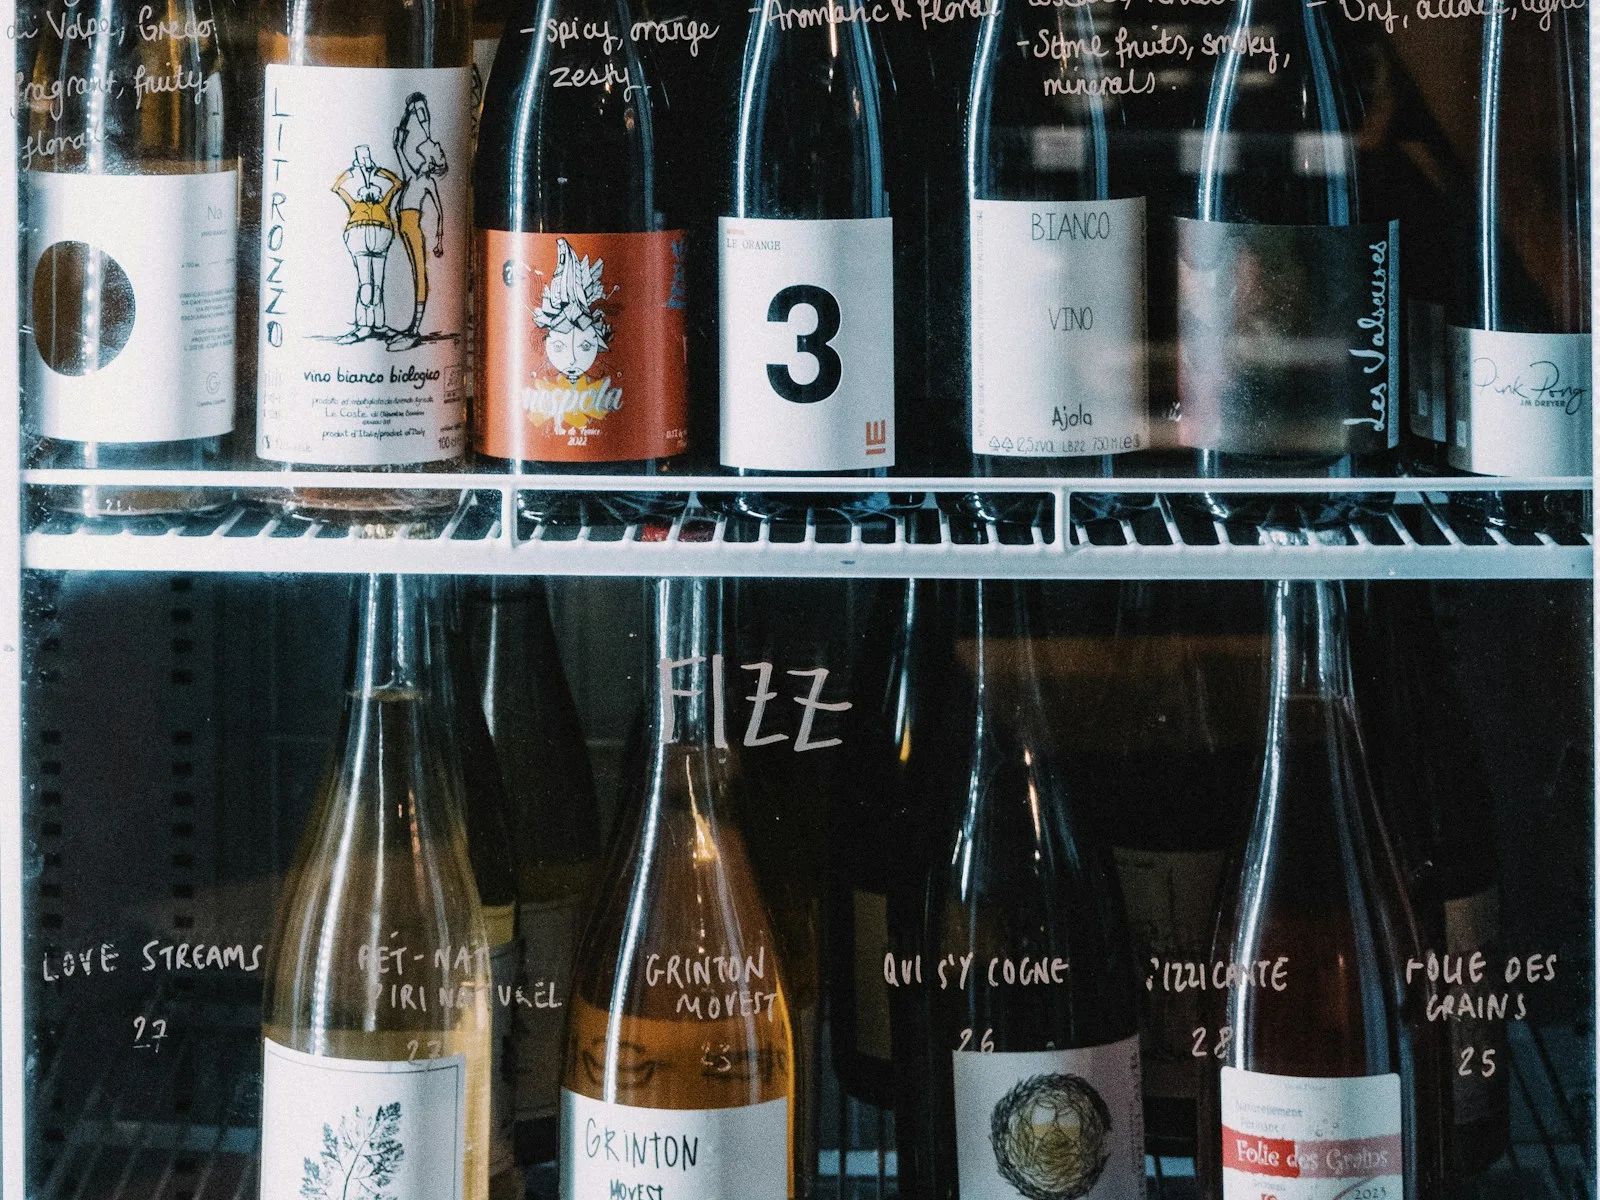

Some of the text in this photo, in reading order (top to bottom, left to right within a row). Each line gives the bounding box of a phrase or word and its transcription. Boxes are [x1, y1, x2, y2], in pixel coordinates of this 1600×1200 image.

[630, 14, 720, 57] orange
[1031, 212, 1110, 241] BIANCO
[742, 239, 781, 251] ORANGE
[1048, 307, 1093, 331] VINO
[766, 284, 842, 404] 3
[304, 369, 331, 383] vino
[337, 366, 384, 383] bianco
[390, 365, 440, 389] biologico
[1530, 361, 1587, 415] Pong
[1052, 403, 1092, 431] Ajola
[1343, 382, 1387, 432] Les
[656, 654, 853, 752] FIZZ
[43, 940, 263, 981] LOVE STREAMS
[646, 947, 764, 988] GRINTON
[883, 953, 922, 987] QUI
[988, 956, 1069, 987] COGNE
[1505, 954, 1557, 983] DES
[676, 992, 777, 1023] MOVEST
[1426, 993, 1527, 1022] GRAINS
[1191, 1026, 1232, 1059] 28
[1458, 1046, 1496, 1078] 25
[1236, 1138, 1280, 1167] Folie
[1286, 1140, 1320, 1171] des
